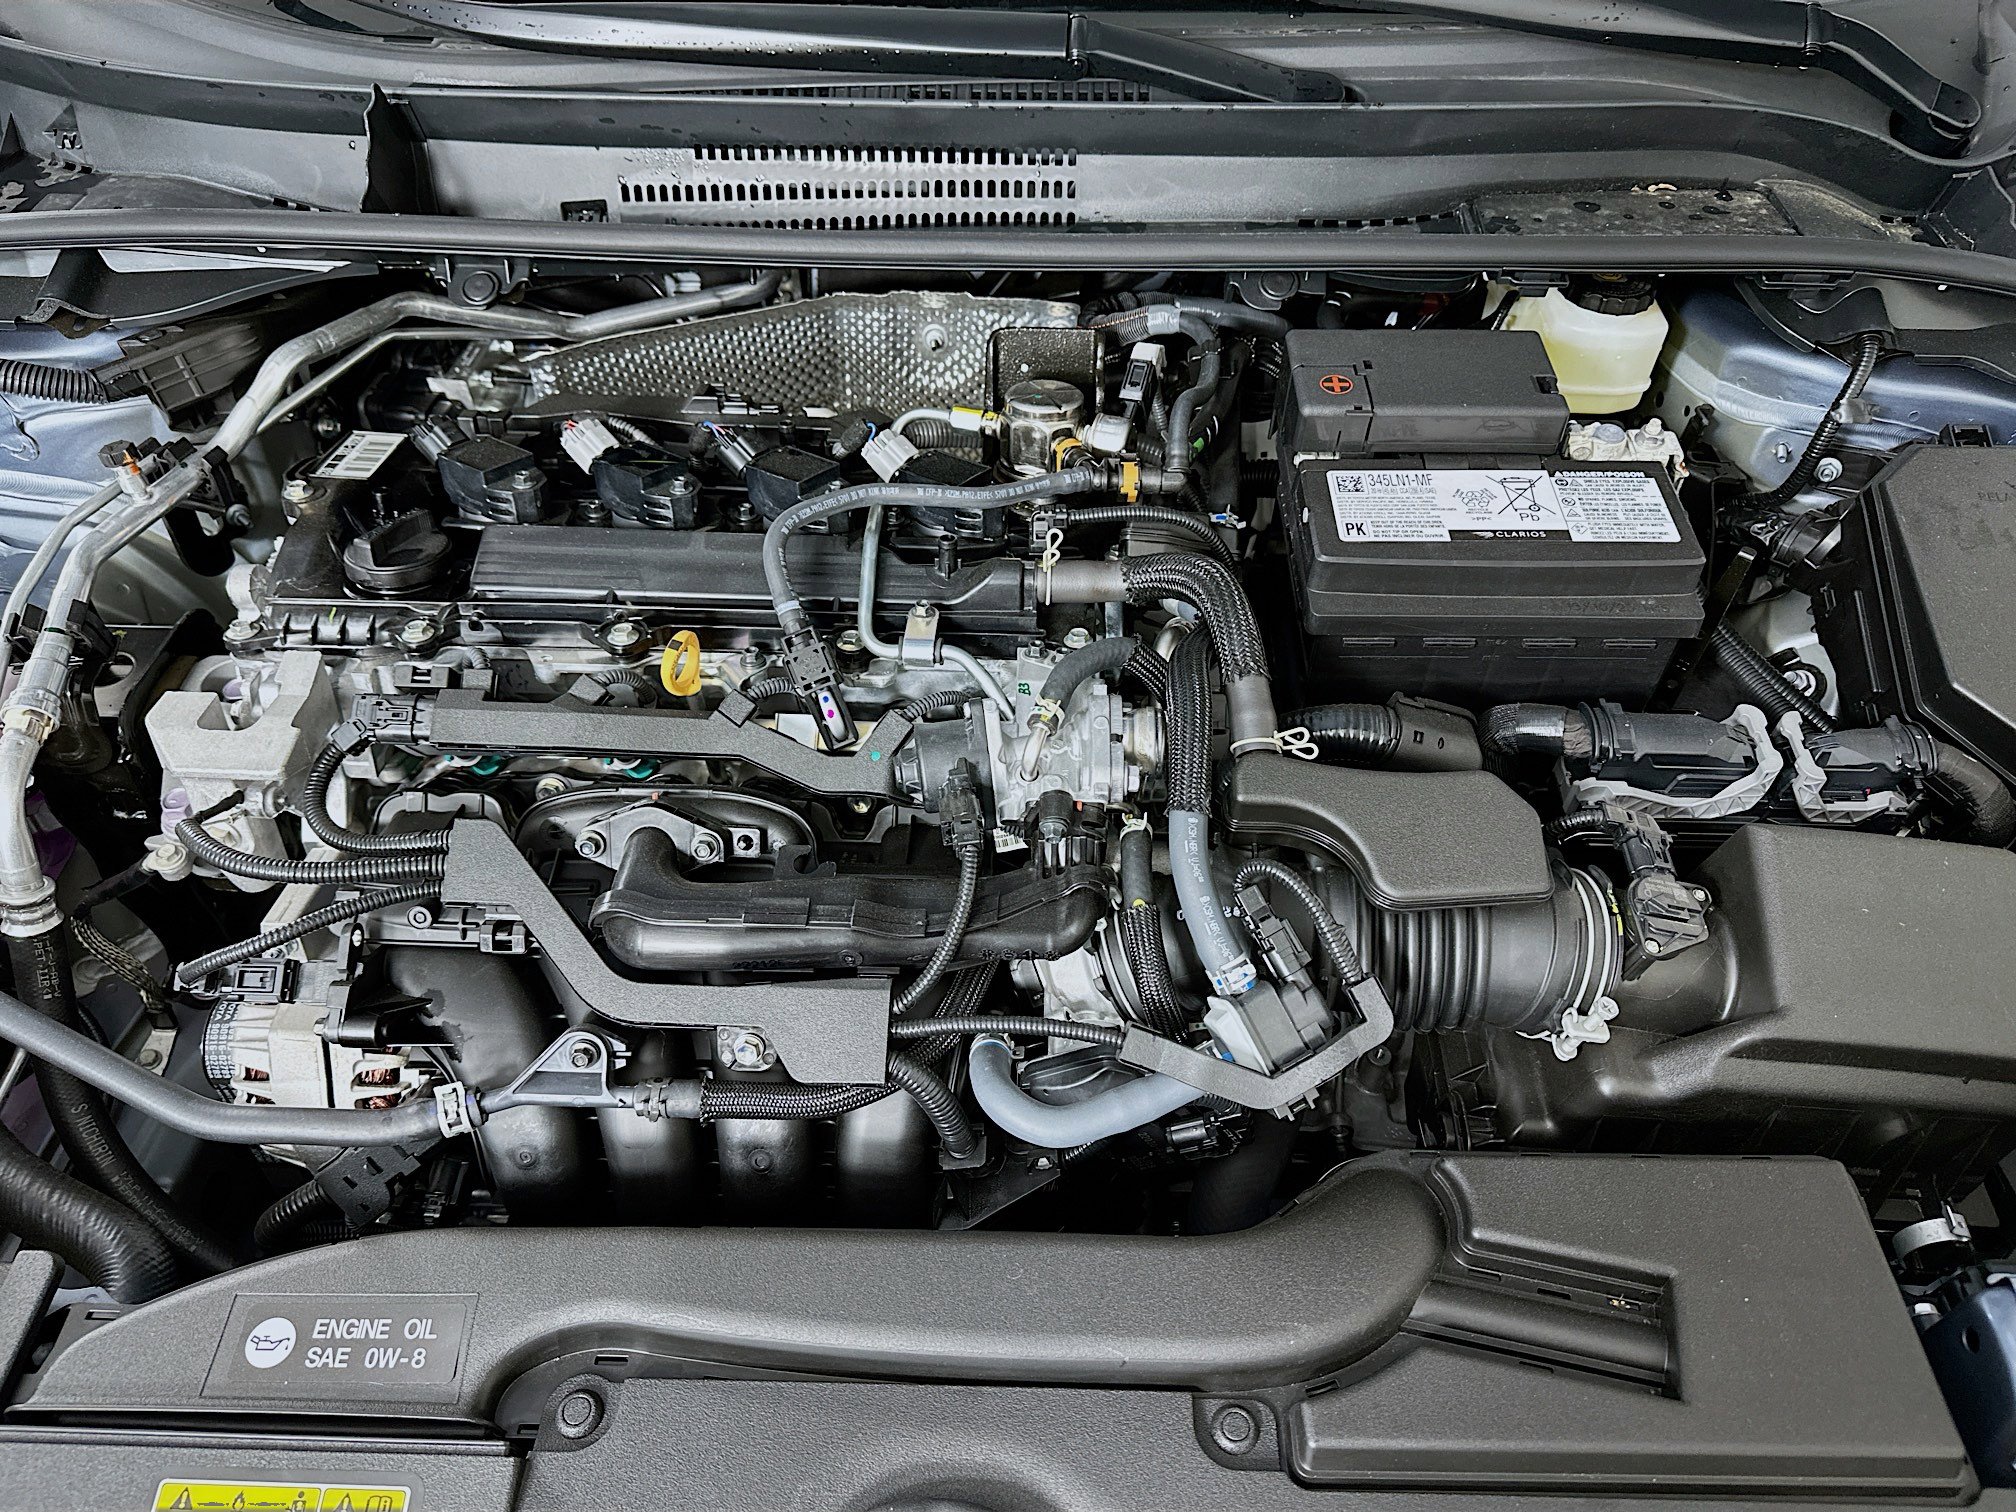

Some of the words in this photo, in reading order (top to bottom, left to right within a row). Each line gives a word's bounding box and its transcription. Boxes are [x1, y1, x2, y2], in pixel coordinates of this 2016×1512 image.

[1367, 474, 1434, 486] 345LN1-MF
[1519, 513, 1540, 521] Pb
[1345, 522, 1366, 536] PK
[75, 1114, 117, 1168] NICHIRIN
[312, 1318, 392, 1340] ENGINE
[404, 1318, 438, 1340] OIL
[304, 1346, 351, 1368] SAE
[364, 1347, 427, 1369] 0W-8
